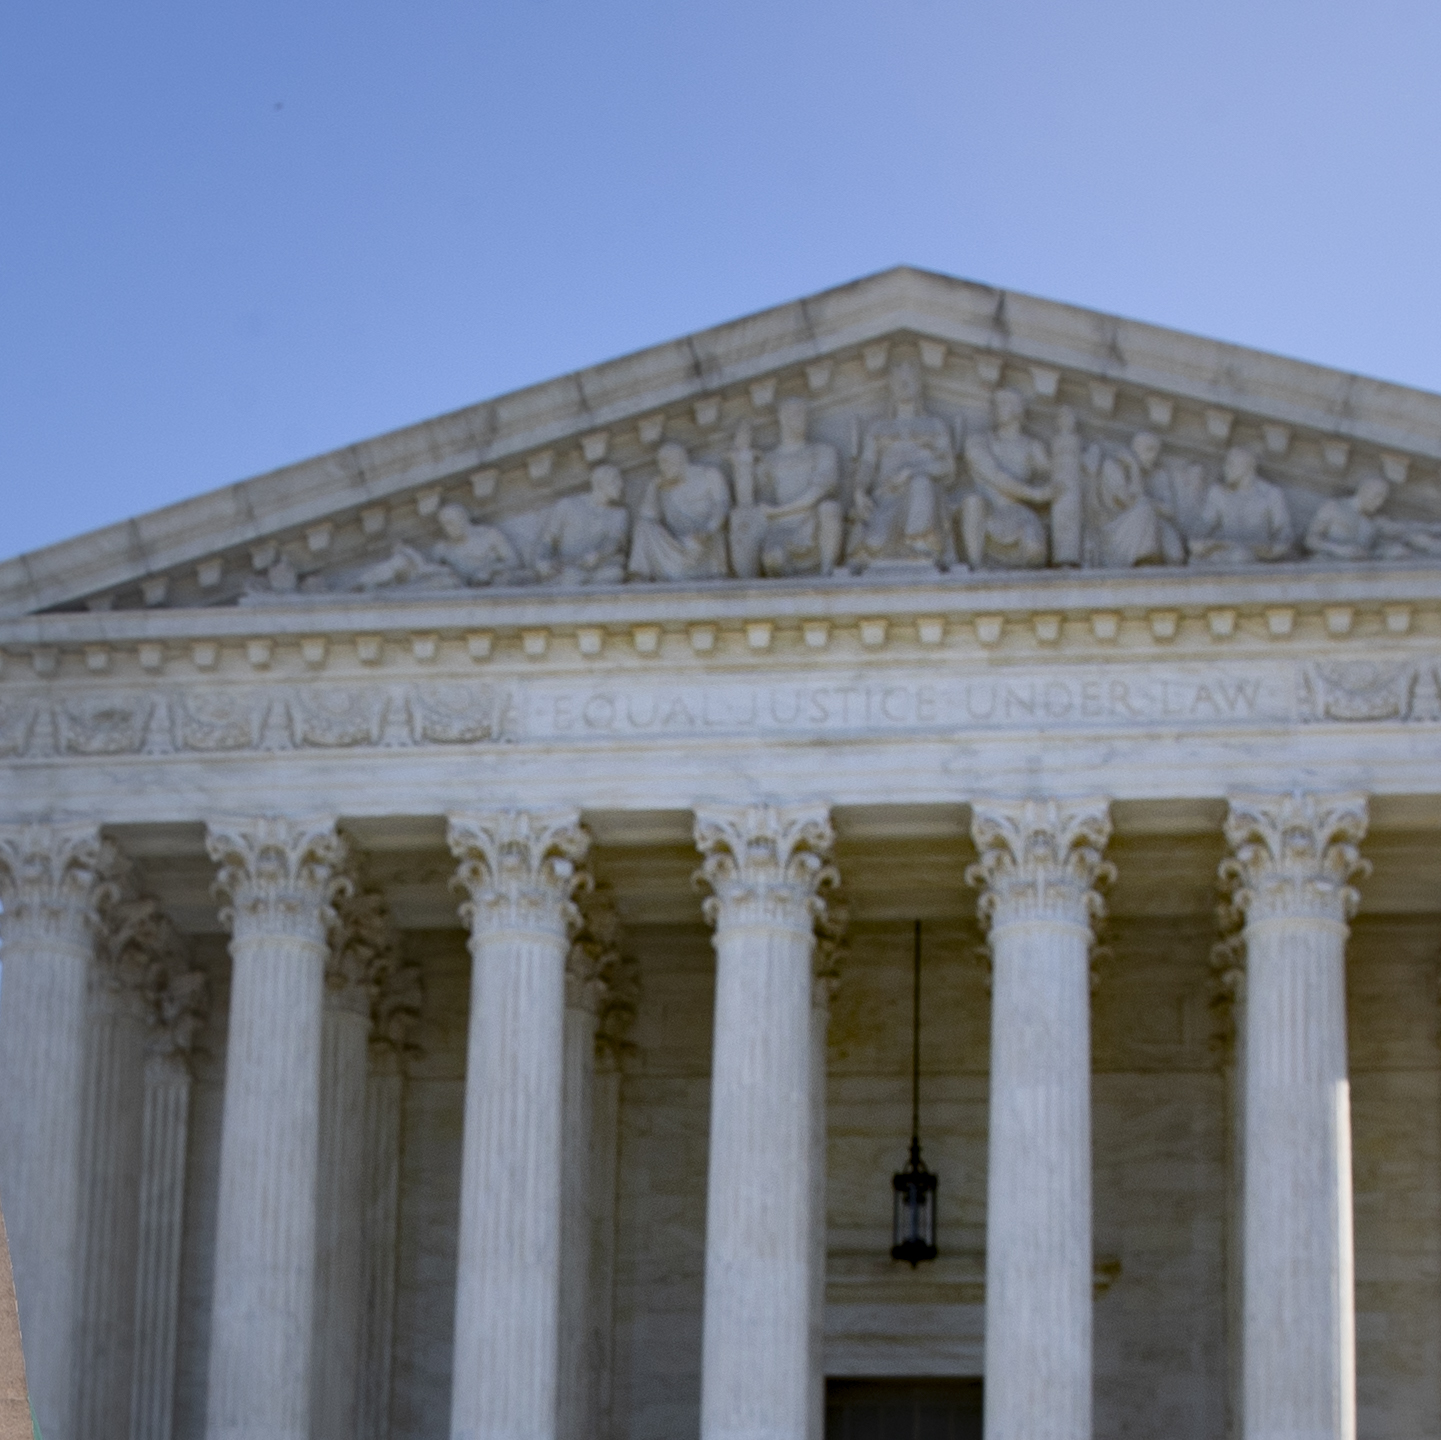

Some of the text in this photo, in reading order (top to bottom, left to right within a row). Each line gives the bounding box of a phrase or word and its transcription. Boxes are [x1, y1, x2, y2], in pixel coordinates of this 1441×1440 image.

[552, 678, 1264, 730] EQUAL JUSTICE UNDER LAW
